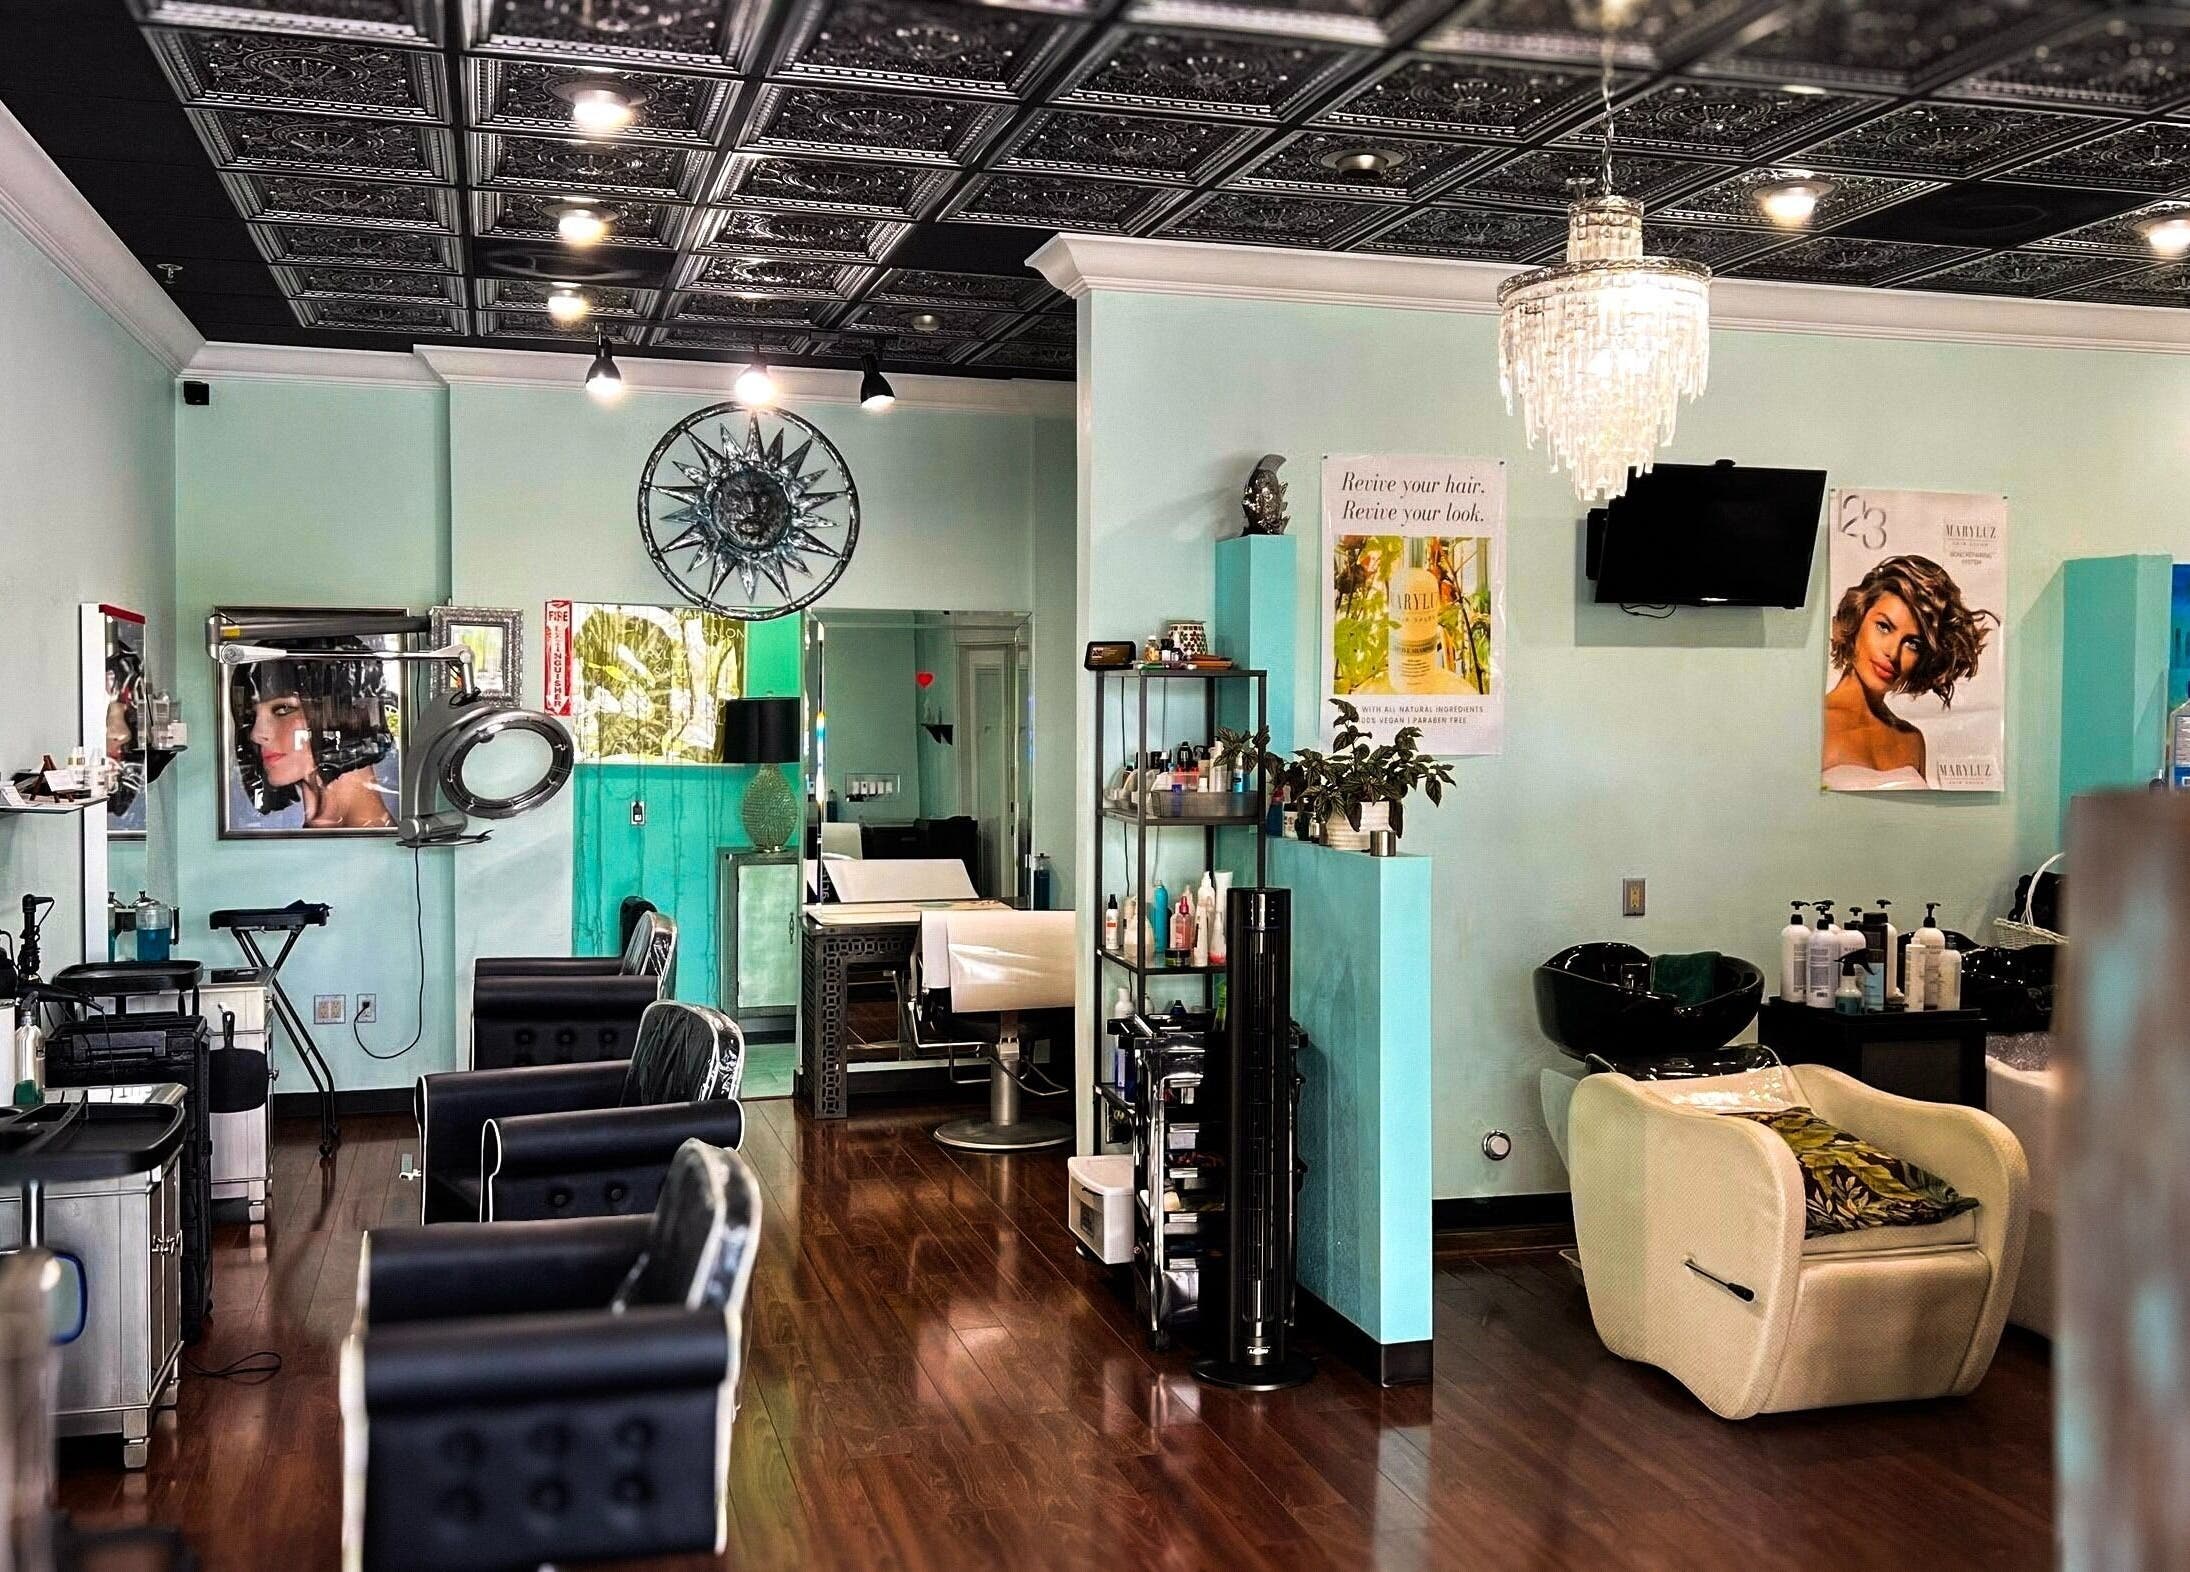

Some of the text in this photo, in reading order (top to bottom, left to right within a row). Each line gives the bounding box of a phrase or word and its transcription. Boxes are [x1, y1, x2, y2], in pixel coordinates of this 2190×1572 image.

[1341, 471, 1485, 499] Revive your hair.
[1342, 500, 1485, 528] Revive your look.
[1946, 524, 1996, 539] MARYLUZ
[548, 611, 568, 622] FIRE
[703, 627, 745, 639] SALON
[1939, 764, 1992, 777] MARYLUZ
